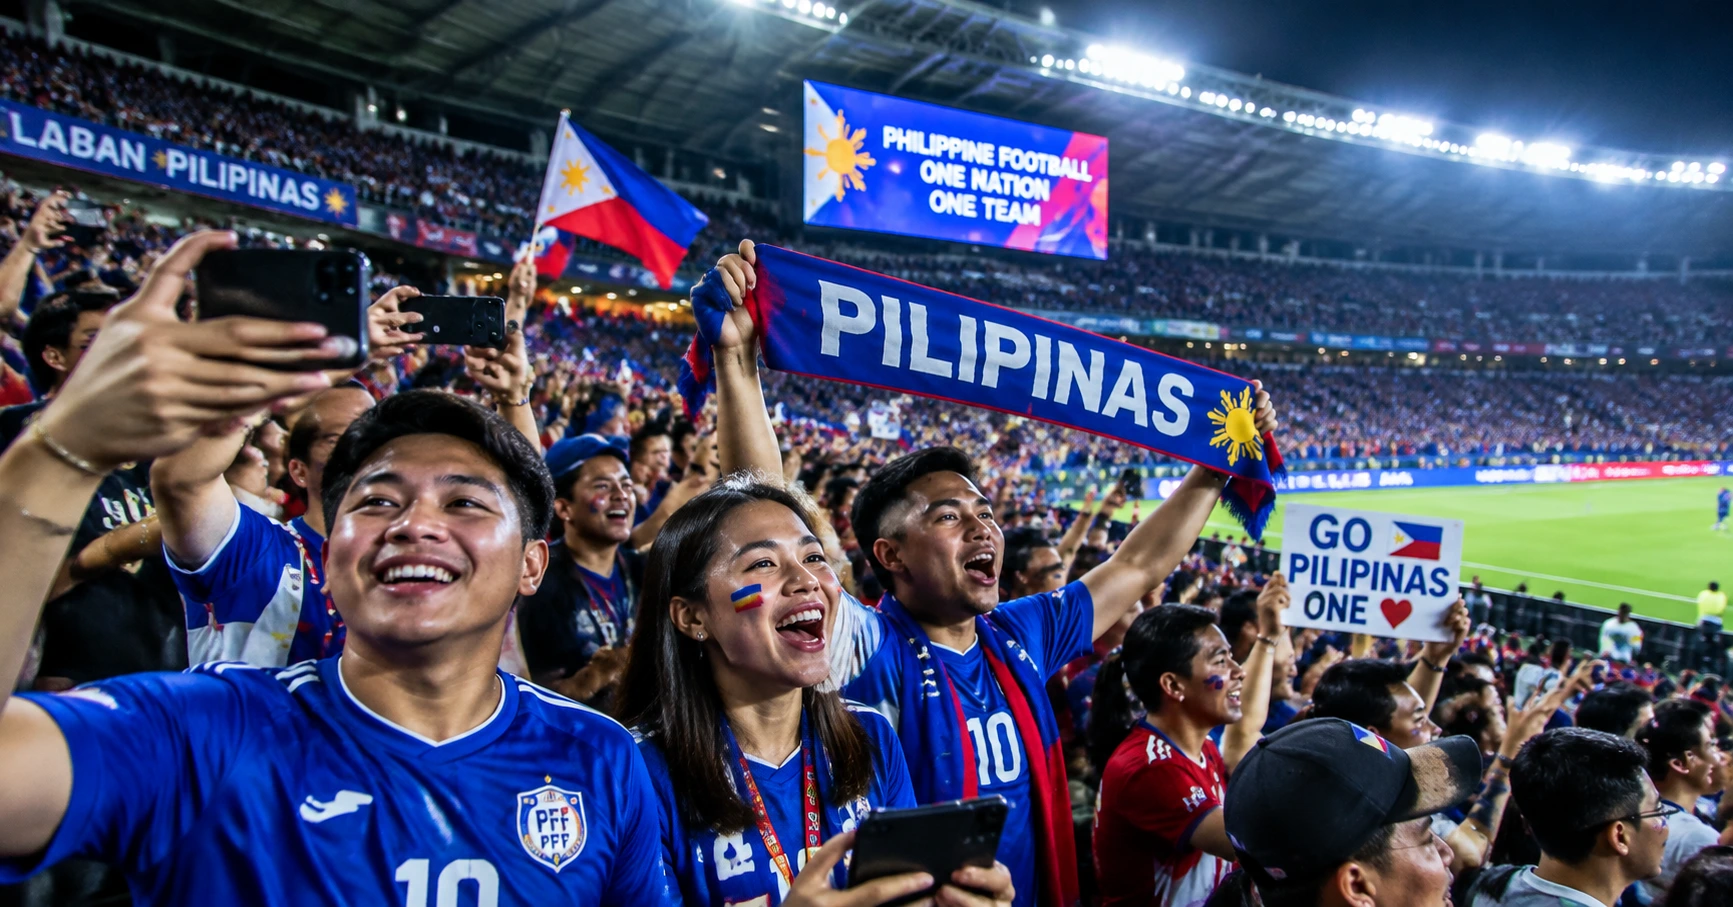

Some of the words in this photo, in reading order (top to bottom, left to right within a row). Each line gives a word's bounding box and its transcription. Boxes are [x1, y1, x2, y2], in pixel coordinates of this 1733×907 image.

[9, 111, 146, 172] LABAN
[165, 148, 320, 210] PILIPINAS
[882, 125, 995, 166] PHILIPPINE
[998, 145, 1093, 183] FOOTBALL
[919, 159, 966, 189] ONE
[971, 167, 1051, 202] NATION
[929, 189, 977, 218] ONE
[981, 196, 1042, 227] TEAM
[818, 279, 1195, 437] PILIPINAS
[1309, 513, 1373, 554] GO
[1288, 552, 1450, 598] PILIPINAS
[1303, 590, 1369, 626] ONE
[966, 711, 1021, 786] 10
